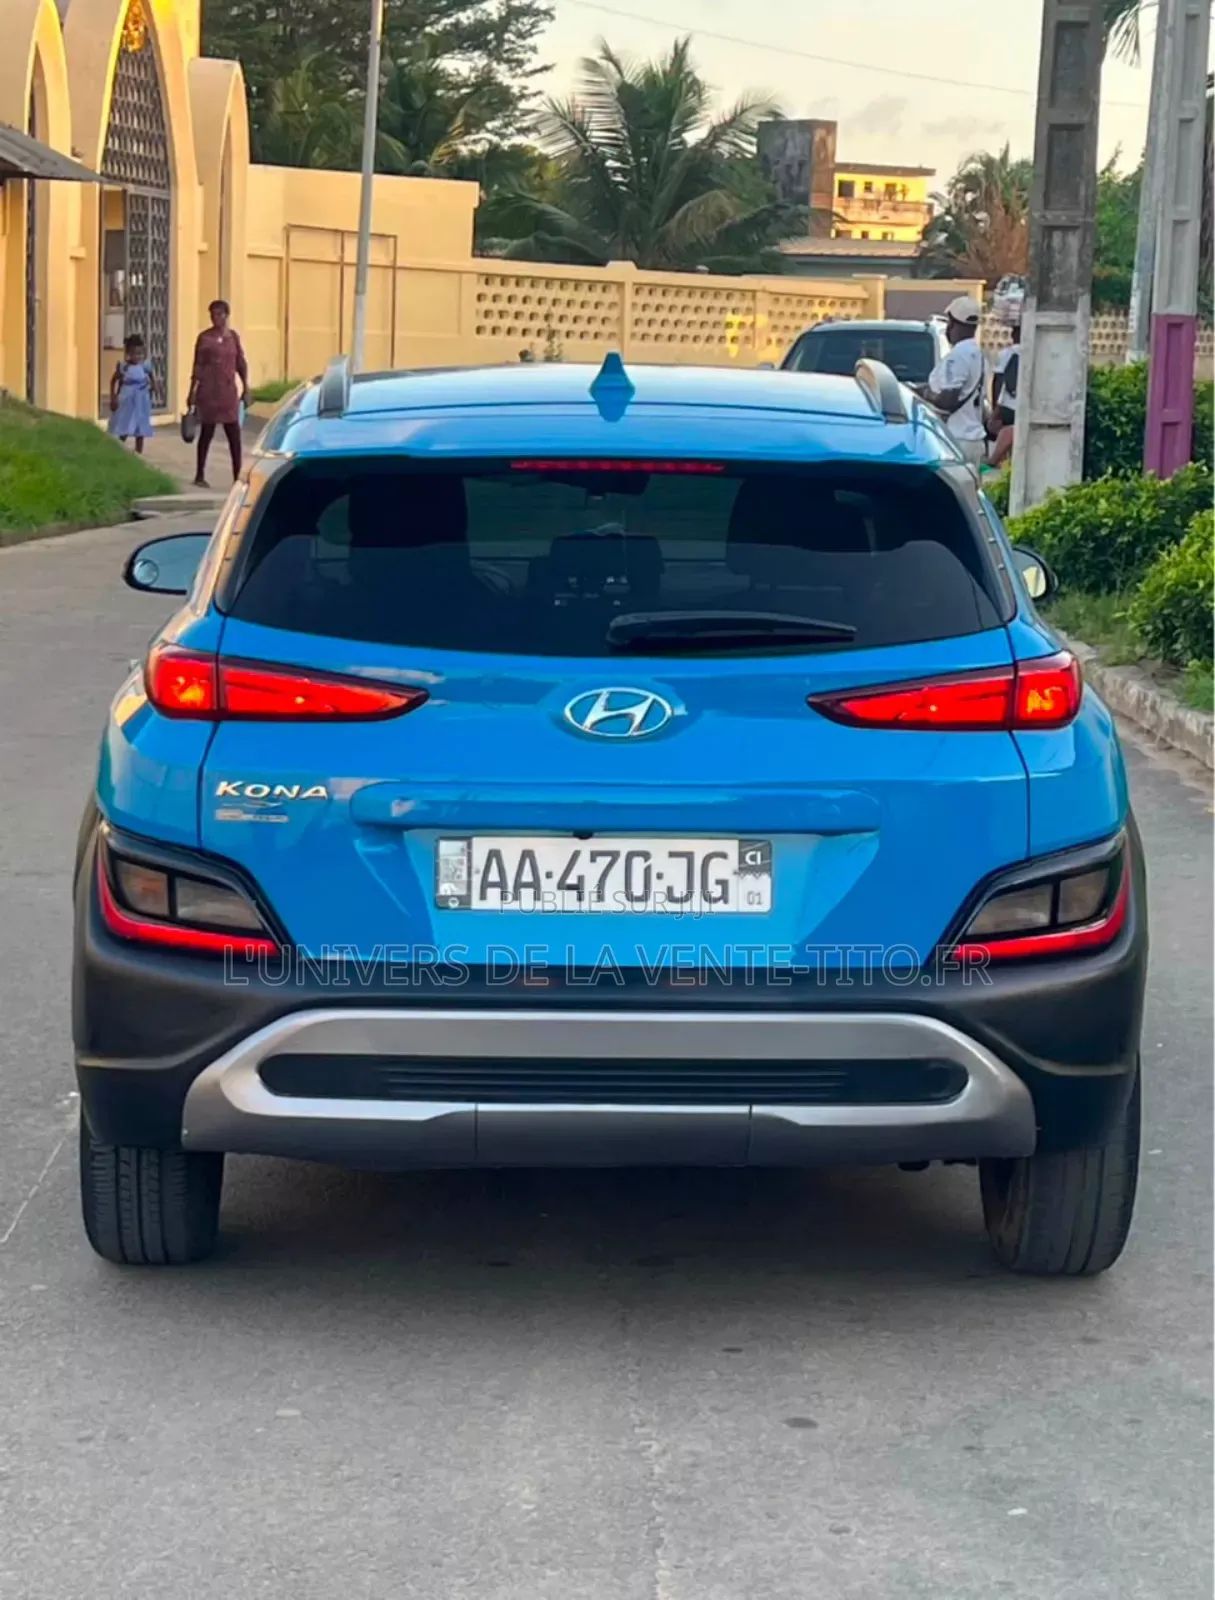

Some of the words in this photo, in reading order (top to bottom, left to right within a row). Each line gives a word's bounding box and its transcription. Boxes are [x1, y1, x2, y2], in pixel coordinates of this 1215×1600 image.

[215, 781, 328, 800] KONA
[745, 851, 761, 865] CI
[746, 891, 763, 905] 01
